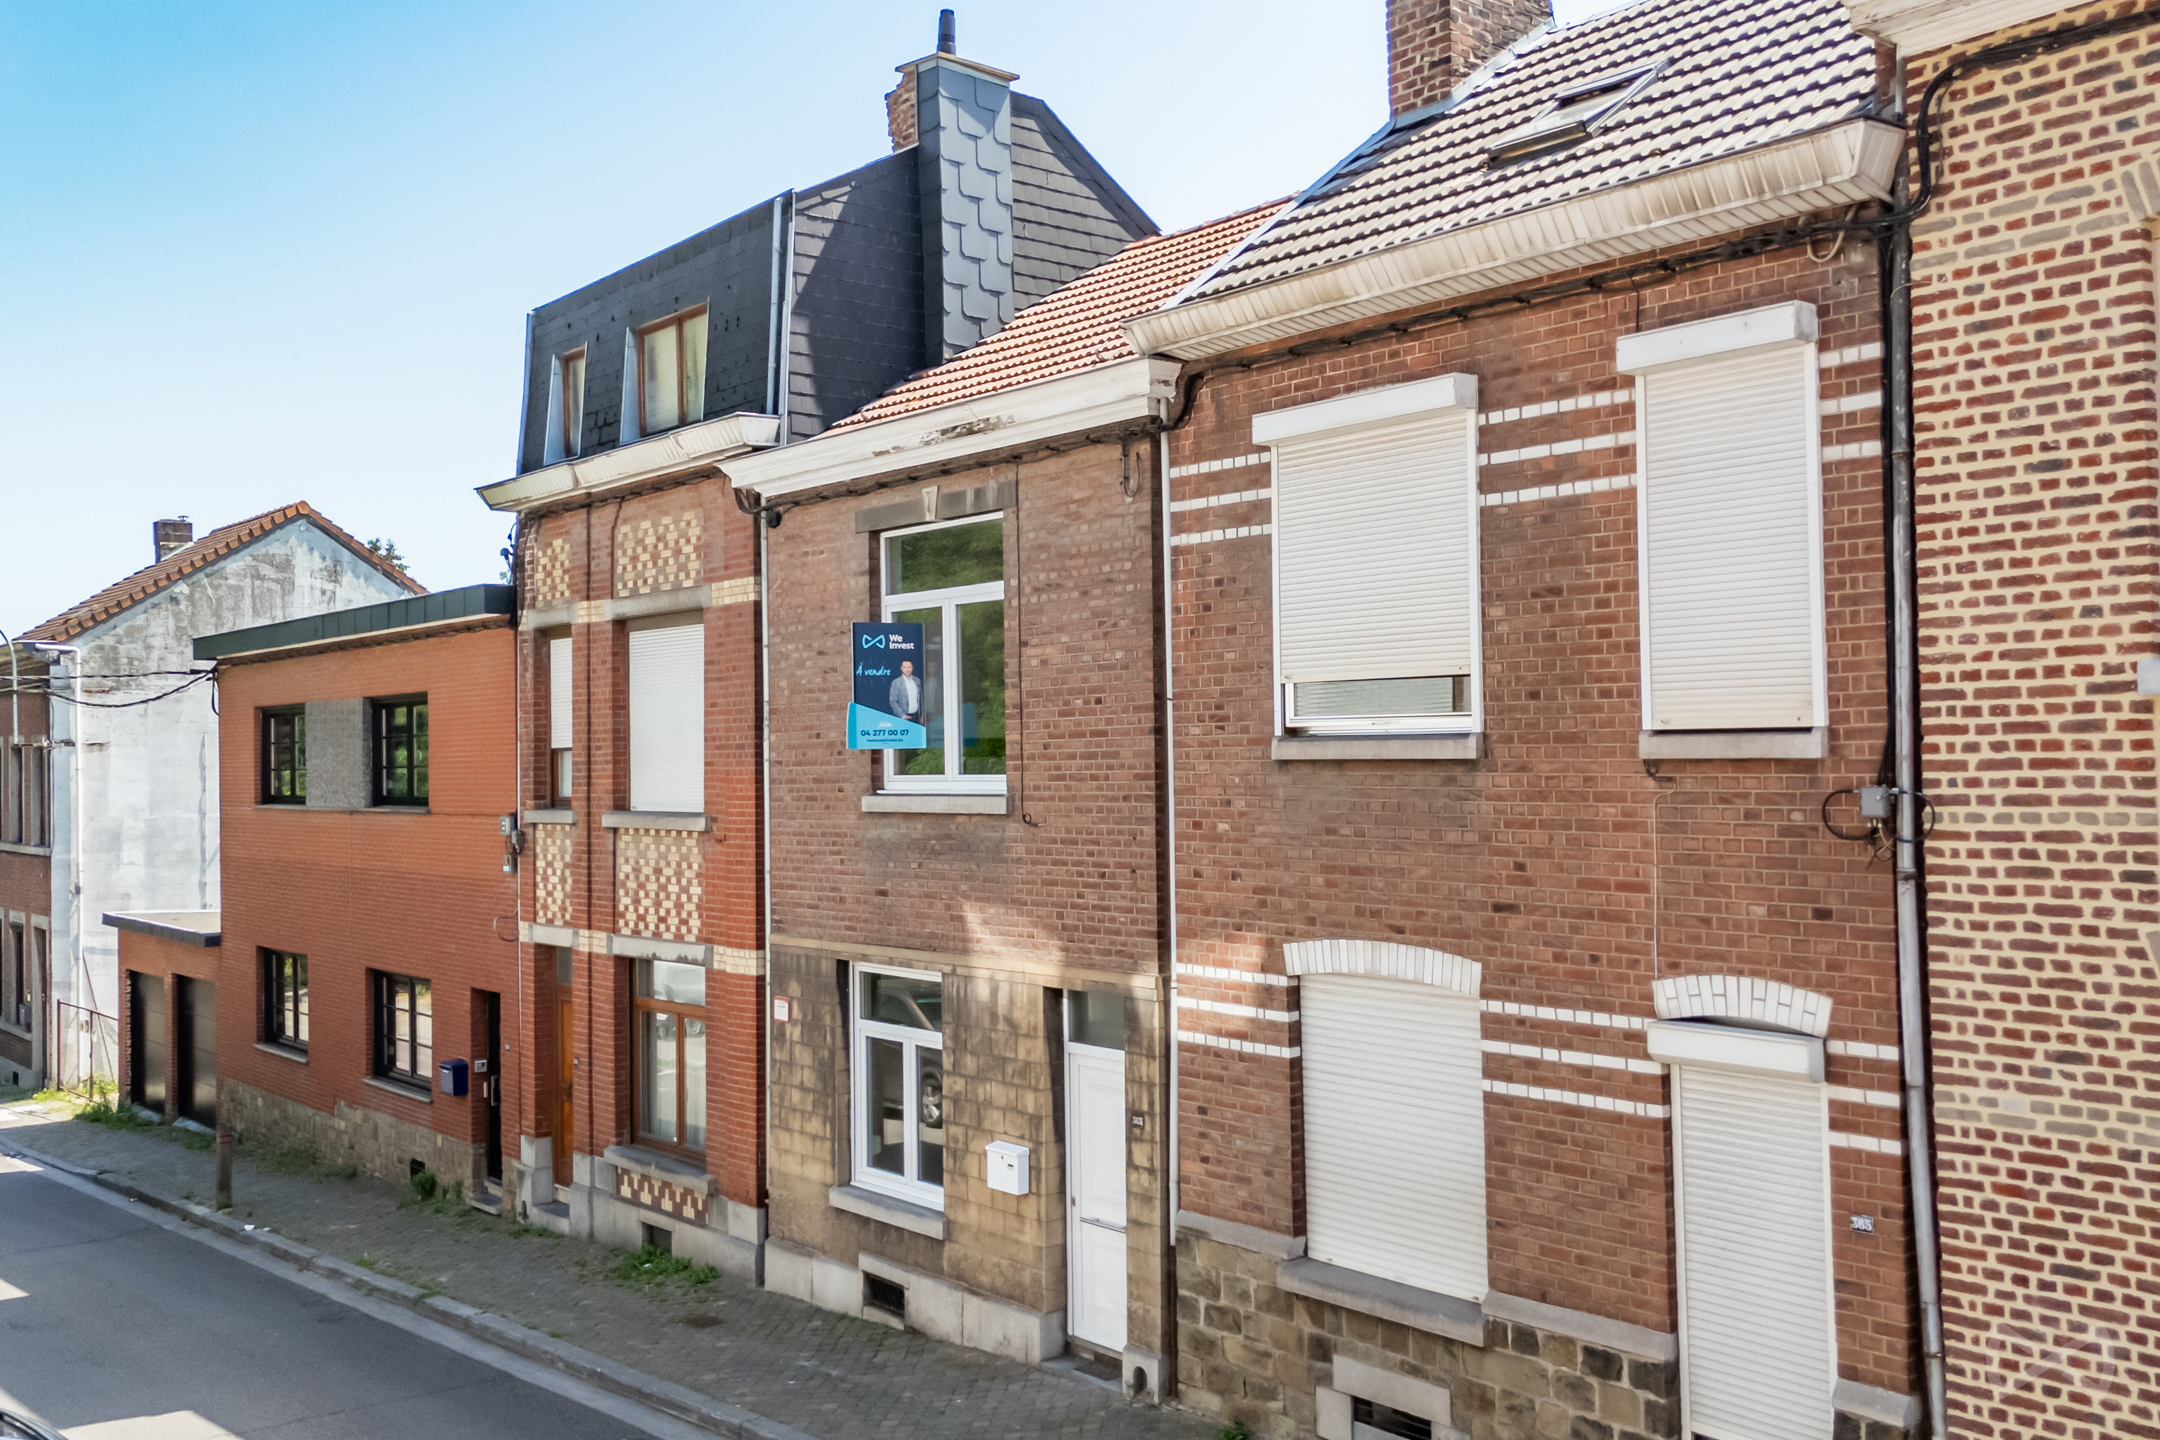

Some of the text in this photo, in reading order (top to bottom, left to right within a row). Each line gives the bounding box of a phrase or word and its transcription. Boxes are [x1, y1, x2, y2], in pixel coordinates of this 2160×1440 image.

[889, 634, 903, 642] We
[856, 662, 891, 676] À vendre
[1851, 1216, 1872, 1231] 365
